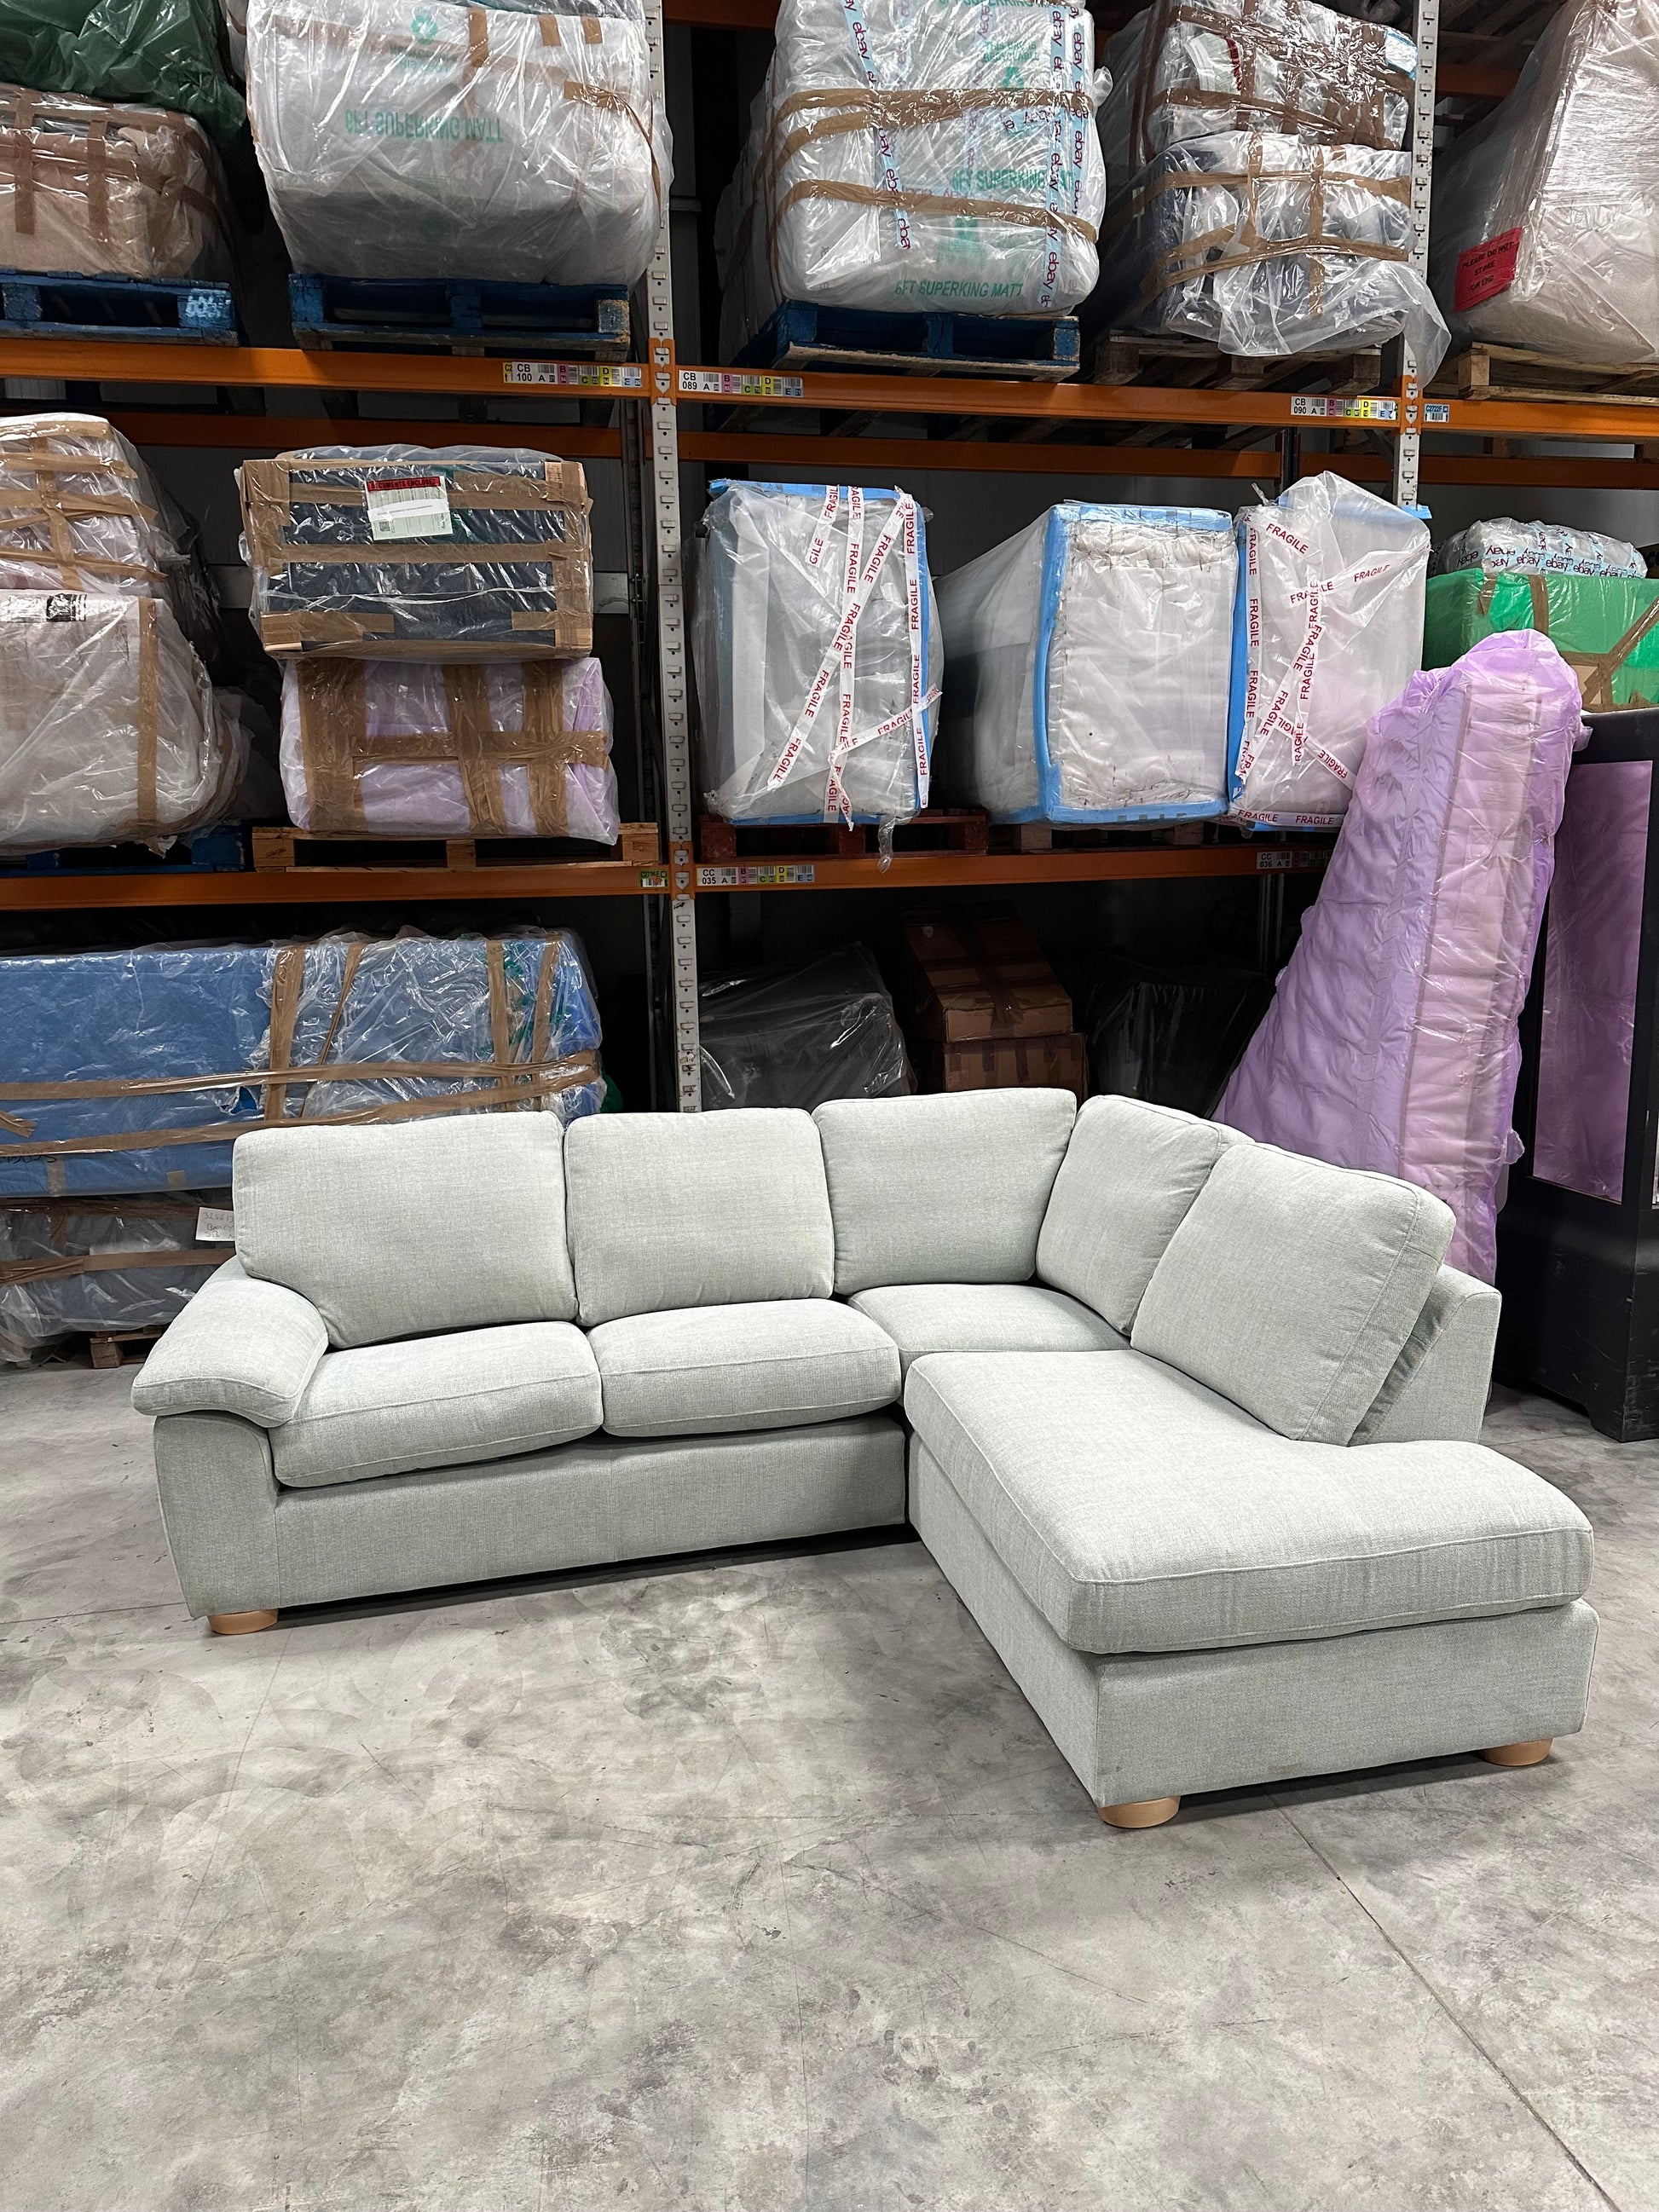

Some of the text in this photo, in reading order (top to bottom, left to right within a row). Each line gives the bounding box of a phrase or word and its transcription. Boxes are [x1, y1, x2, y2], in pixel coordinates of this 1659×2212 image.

[853, 21, 870, 60] ebay
[1051, 10, 1065, 47] ebay
[1073, 32, 1085, 72] ebay
[877, 128, 892, 158] bay
[1072, 130, 1085, 170] ebay
[975, 169, 1048, 190] SUPERKING
[897, 217, 911, 251] eba
[1043, 251, 1060, 291] ebay
[1461, 241, 1515, 270] PLEASE DO NOT
[1473, 260, 1496, 277] STORE
[895, 280, 1024, 297] 6FT SUPERKING MATT
[1481, 274, 1494, 286] END
[517, 363, 531, 373] CB
[517, 373, 533, 382] 100
[581, 376, 588, 384] C
[683, 372, 697, 381] CB
[682, 381, 697, 390] 089
[744, 385, 751, 394] C
[1293, 406, 1307, 414] 090
[824, 486, 839, 519] FRAGIL
[850, 486, 861, 519] RAGILE
[905, 503, 915, 554] FRAGILE
[1265, 523, 1309, 555] FRAGILE
[809, 537, 824, 564] GILE
[864, 534, 892, 584] FRAGILE
[1516, 555, 1540, 568] ebay
[1546, 558, 1569, 572] ebay
[847, 543, 860, 593] FRAGILE
[1353, 563, 1391, 583] FRAGILE
[1573, 564, 1595, 575] ebay
[910, 579, 920, 630] FRAGILE
[1290, 580, 1334, 604] FRALE
[834, 603, 861, 651] FRAGILE
[1250, 598, 1260, 647] FRAGILE
[1292, 624, 1322, 672] FRAGILE
[804, 669, 830, 719] FRAGILE
[912, 654, 921, 704] FRAGILE
[1246, 670, 1259, 719] FRAGILE
[839, 693, 851, 743] FRAGILE
[877, 709, 912, 735] FRAGIL
[1260, 690, 1289, 736] FRAGILE
[916, 726, 928, 776] FRAGILE
[1293, 722, 1304, 762] RAGILE
[1317, 749, 1348, 779] FRAGILE
[827, 765, 842, 811] FAGILE
[1238, 809, 1279, 823] FRAGILE
[1295, 815, 1335, 825] FRAGILE
[702, 876, 716, 885] 035
